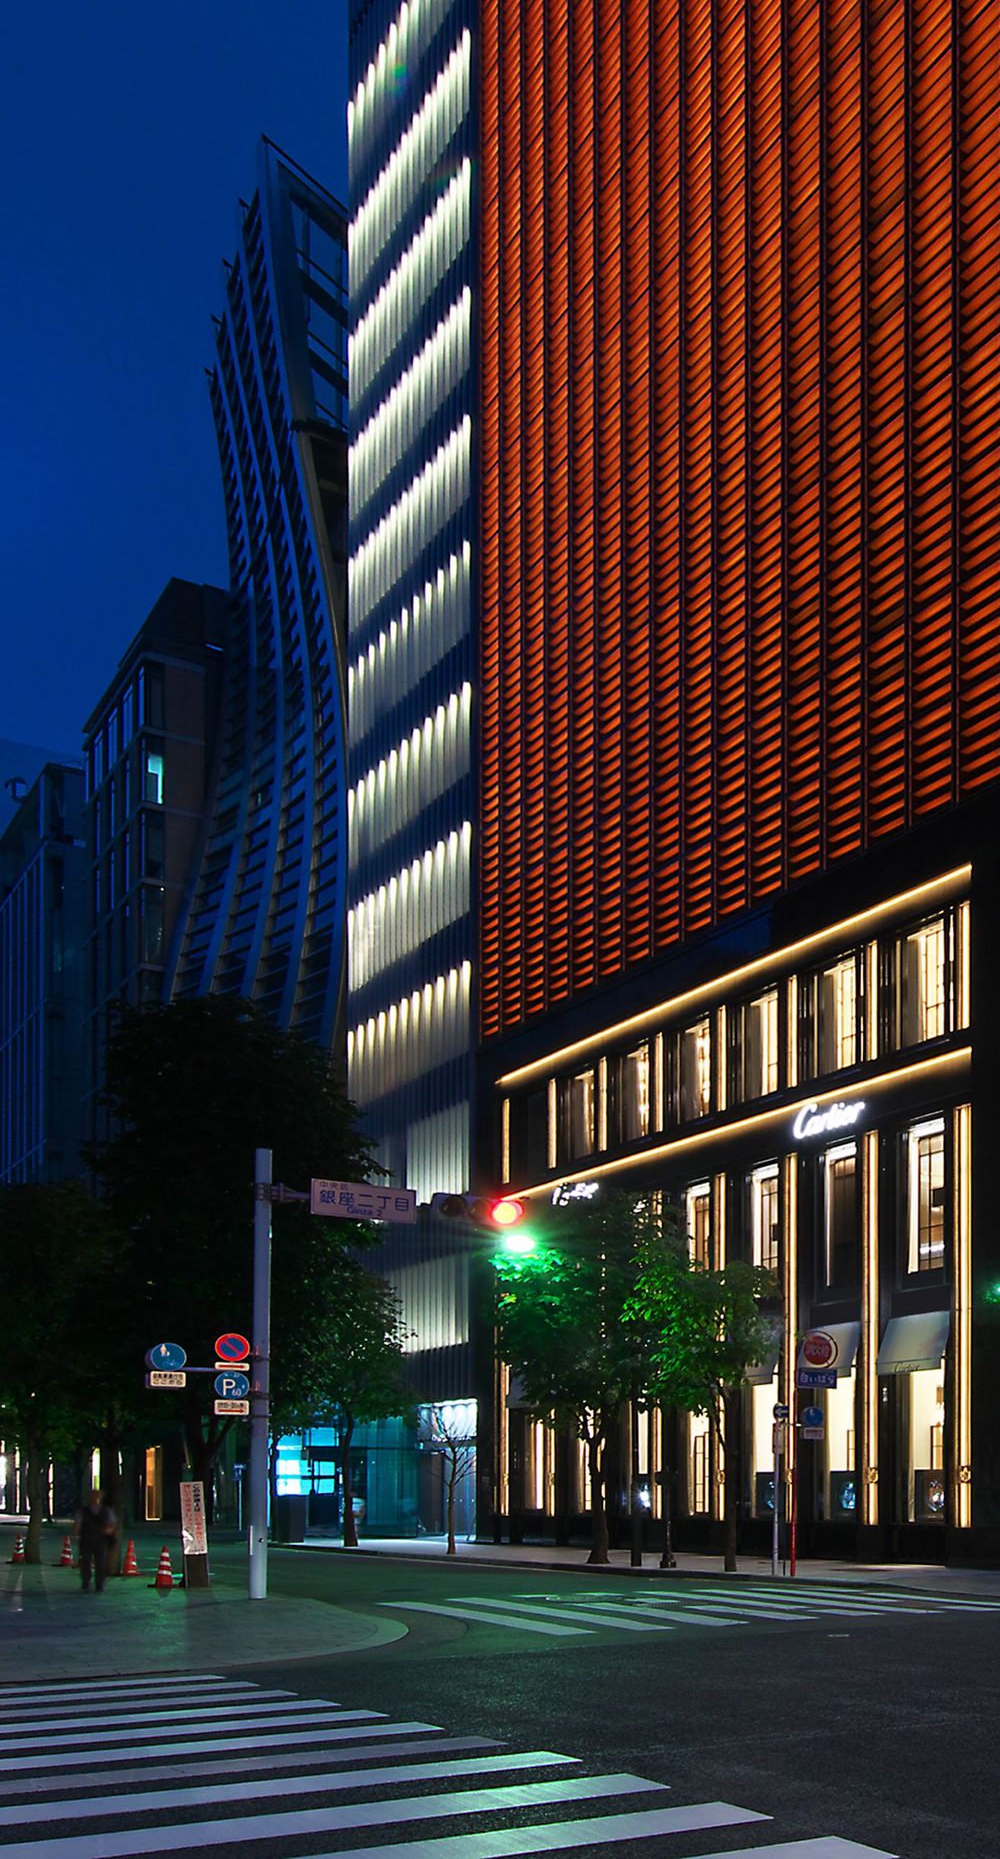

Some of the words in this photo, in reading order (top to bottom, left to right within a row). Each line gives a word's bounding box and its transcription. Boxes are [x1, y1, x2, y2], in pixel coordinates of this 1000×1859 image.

[793, 1101, 866, 1139] Cartier
[320, 1189, 409, 1212] 銀座二丁目
[347, 1204, 373, 1216] Ginza
[377, 1208, 384, 1218] 2
[223, 1378, 236, 1396] P
[231, 1388, 242, 1396] 60
